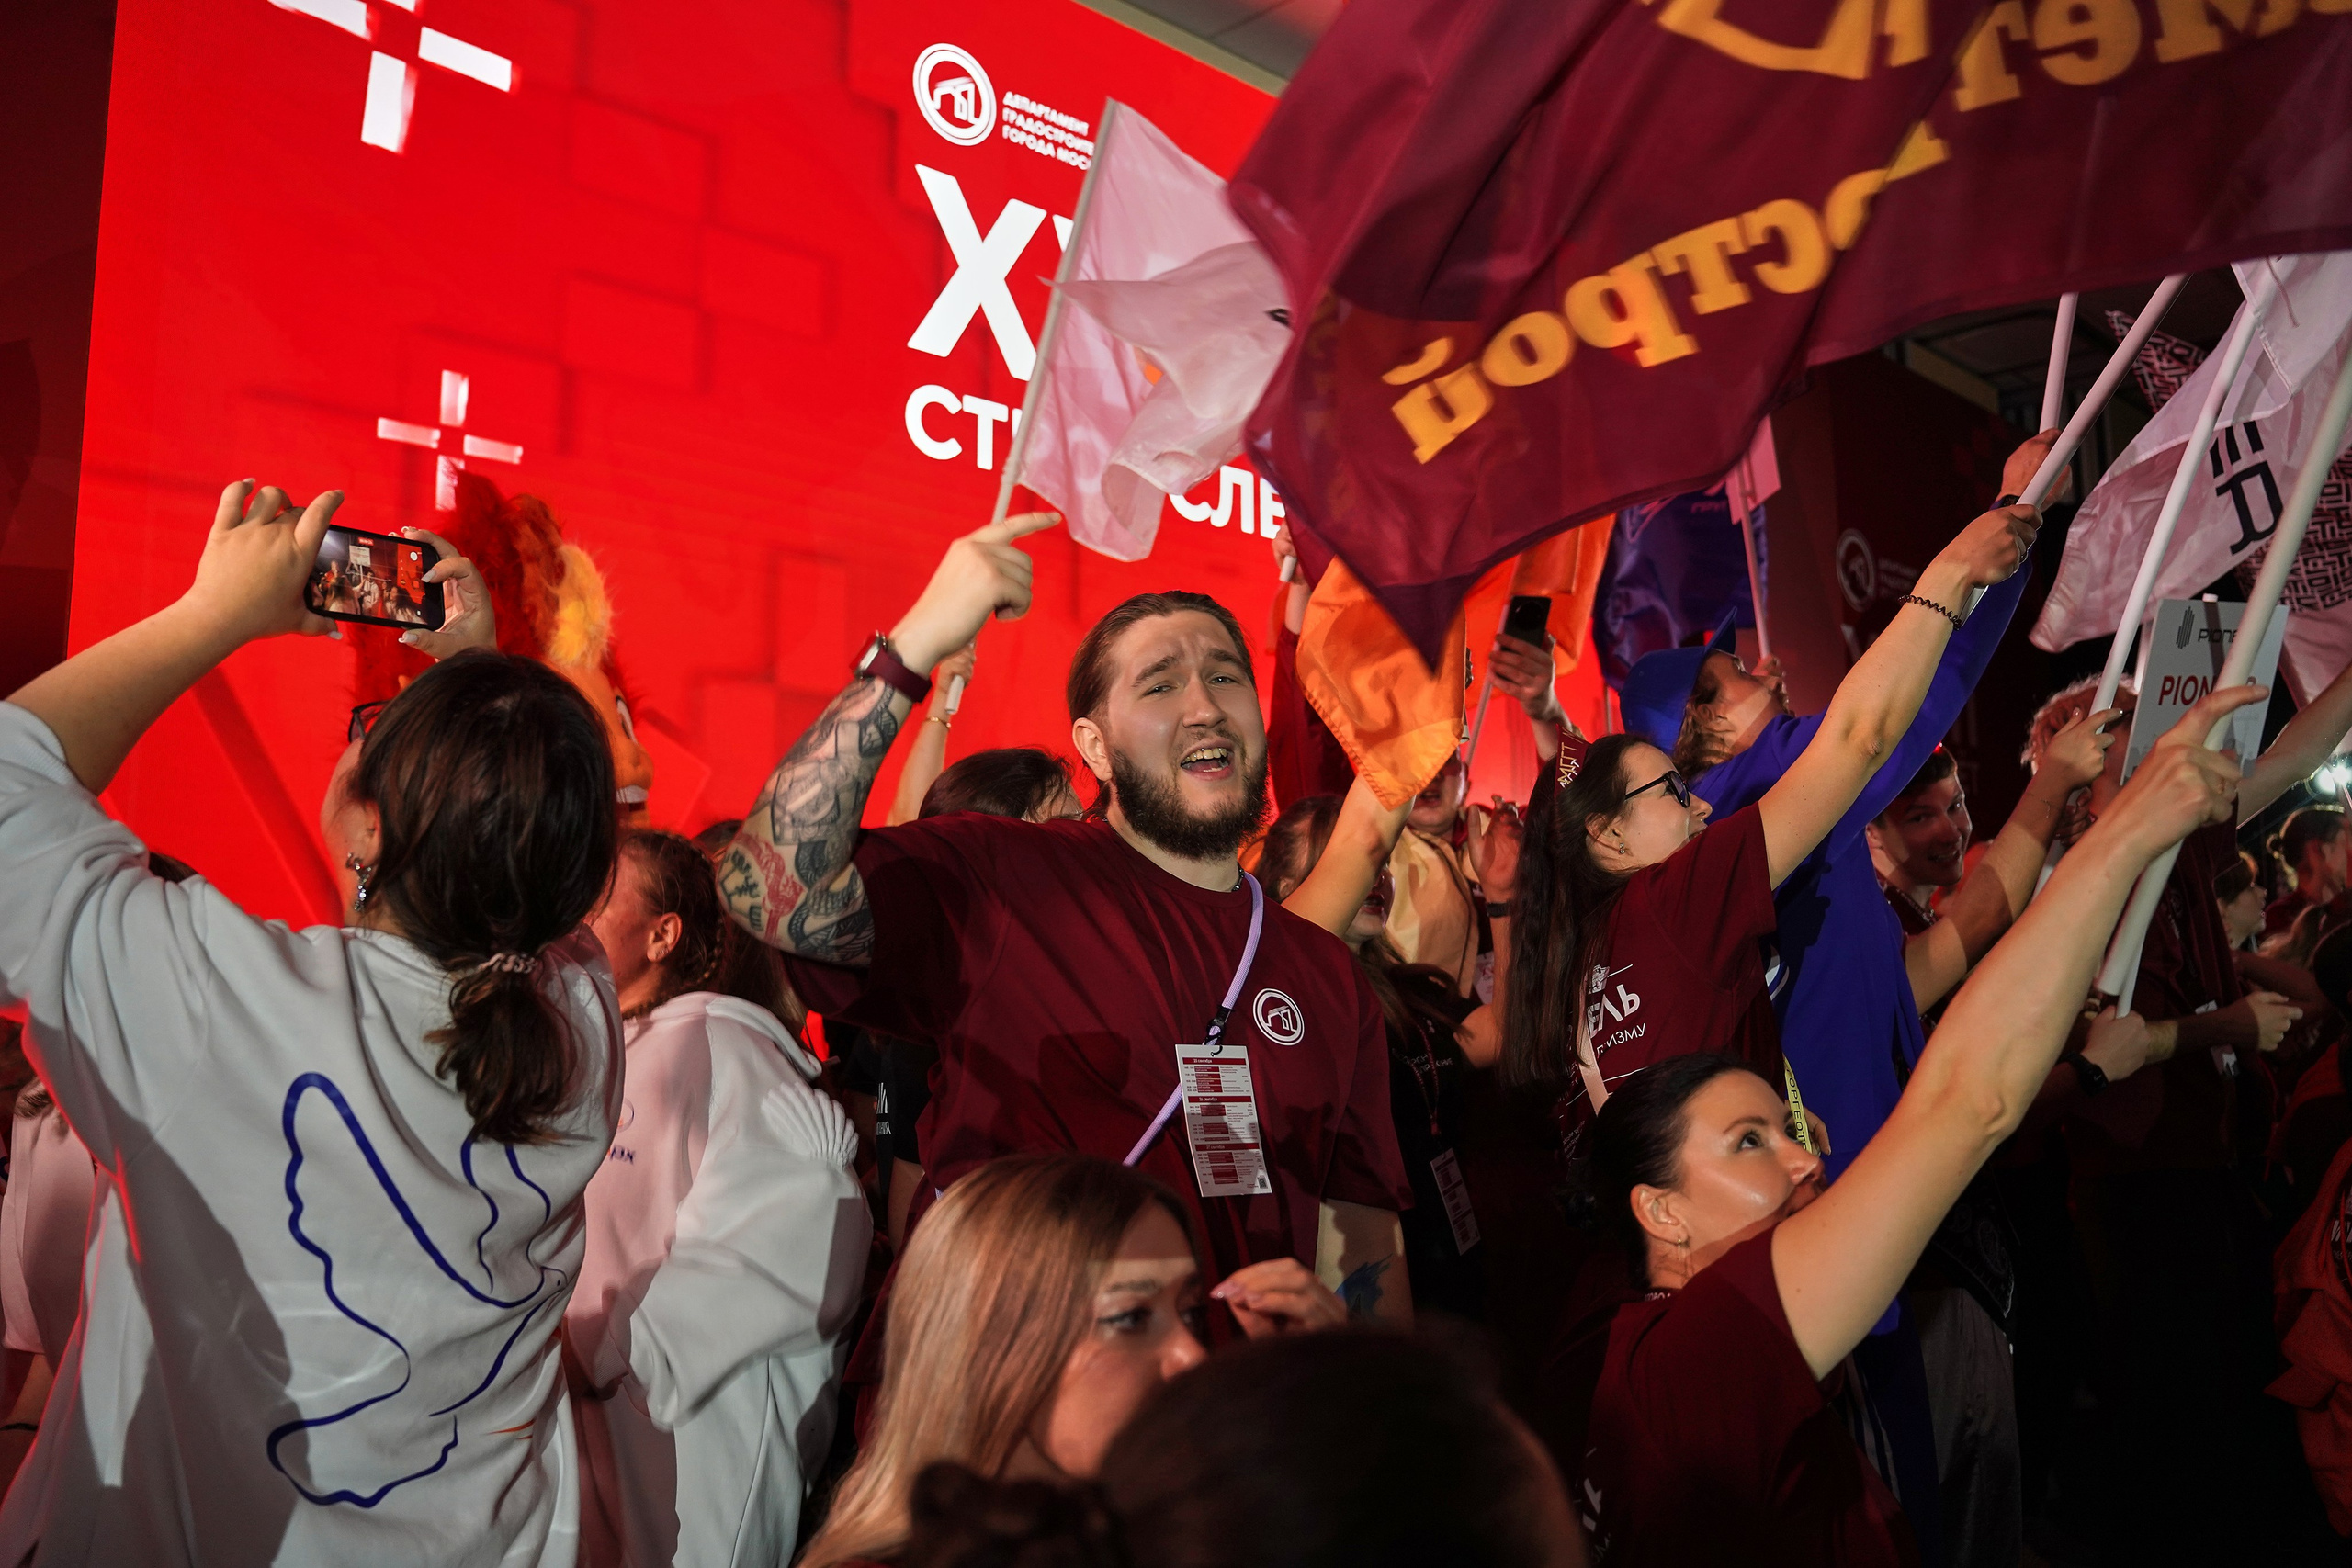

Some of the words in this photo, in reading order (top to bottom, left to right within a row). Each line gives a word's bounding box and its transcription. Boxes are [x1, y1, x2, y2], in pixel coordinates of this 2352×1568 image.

[1002, 91, 1089, 137] ДЕПАРТАМЕНТ
[1002, 107, 1094, 156] ГРАДОСТРОИТЕ
[1002, 125, 1056, 158] ГОРОДА
[1057, 147, 1092, 171] МОС
[907, 164, 1074, 382] X
[905, 384, 1022, 470] СТ
[2159, 675, 2256, 705] PION
[1587, 984, 1641, 1039] ЕЛЬ
